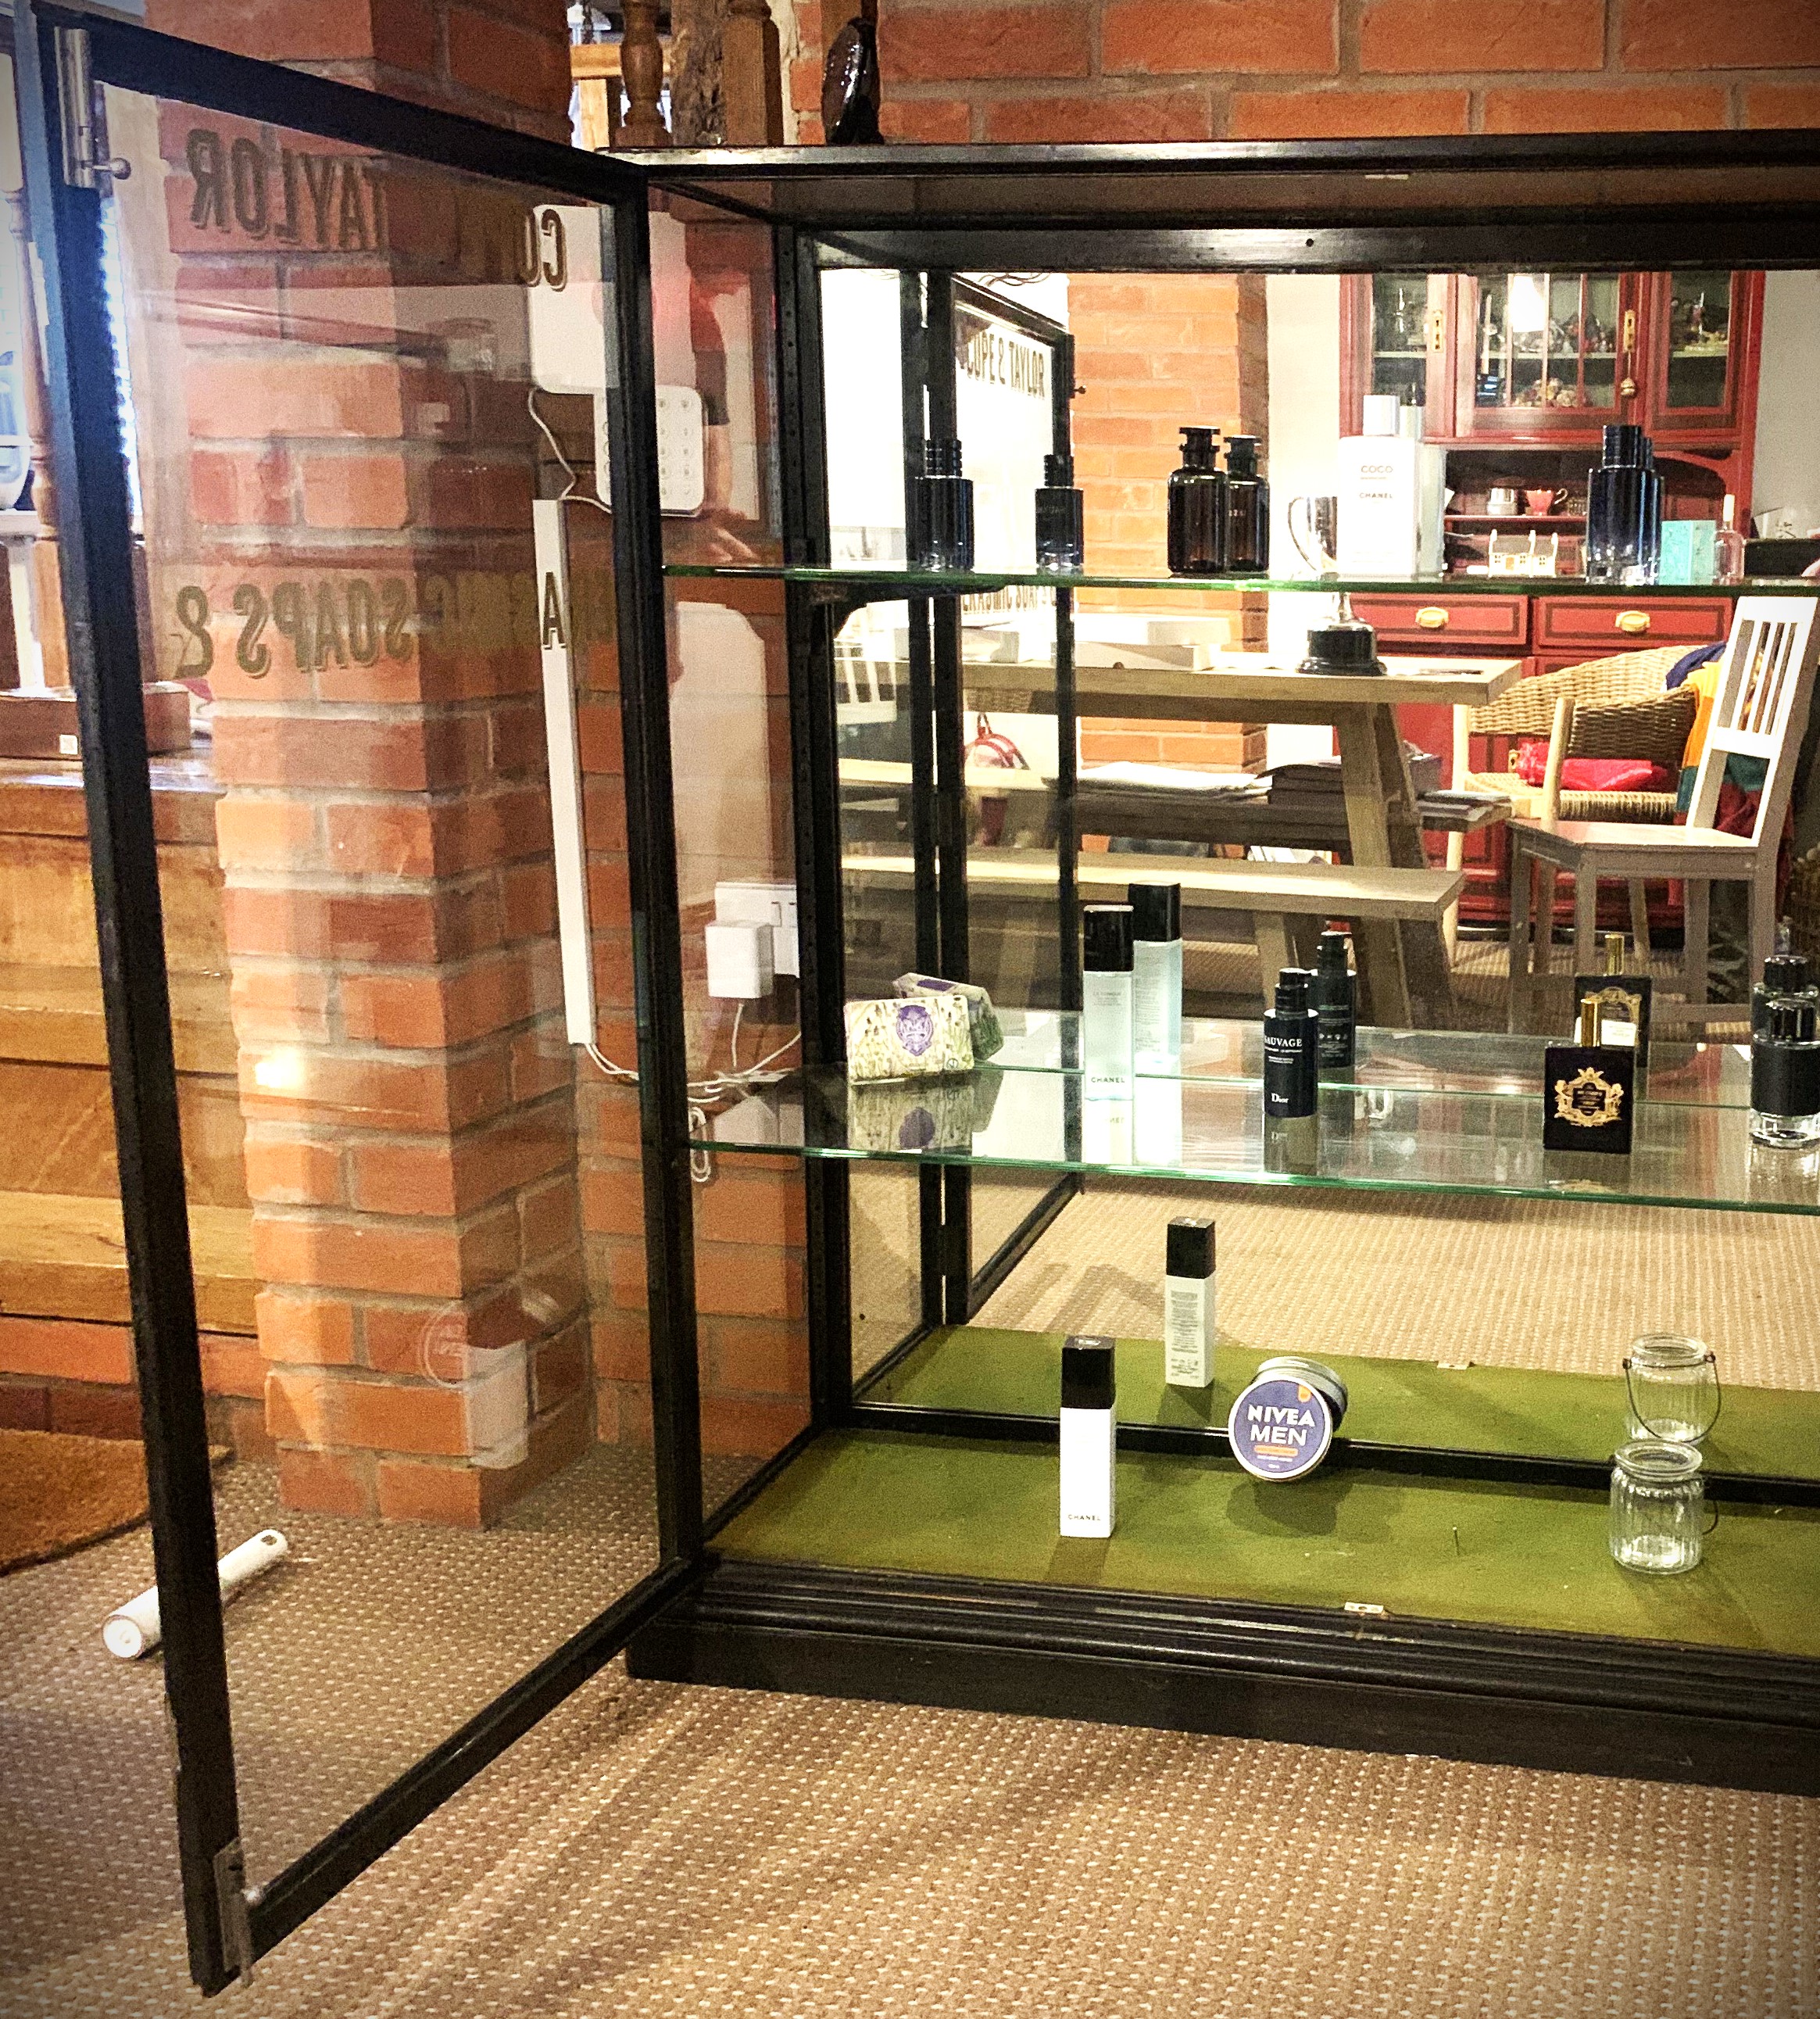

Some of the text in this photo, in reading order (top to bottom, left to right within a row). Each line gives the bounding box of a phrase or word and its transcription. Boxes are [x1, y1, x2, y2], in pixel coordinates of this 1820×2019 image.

[1008, 341, 1045, 400] TAYLOR
[1271, 1093, 1289, 1103] Dior
[1247, 1404, 1315, 1427] NIVEA
[1250, 1424, 1307, 1446] MEN
